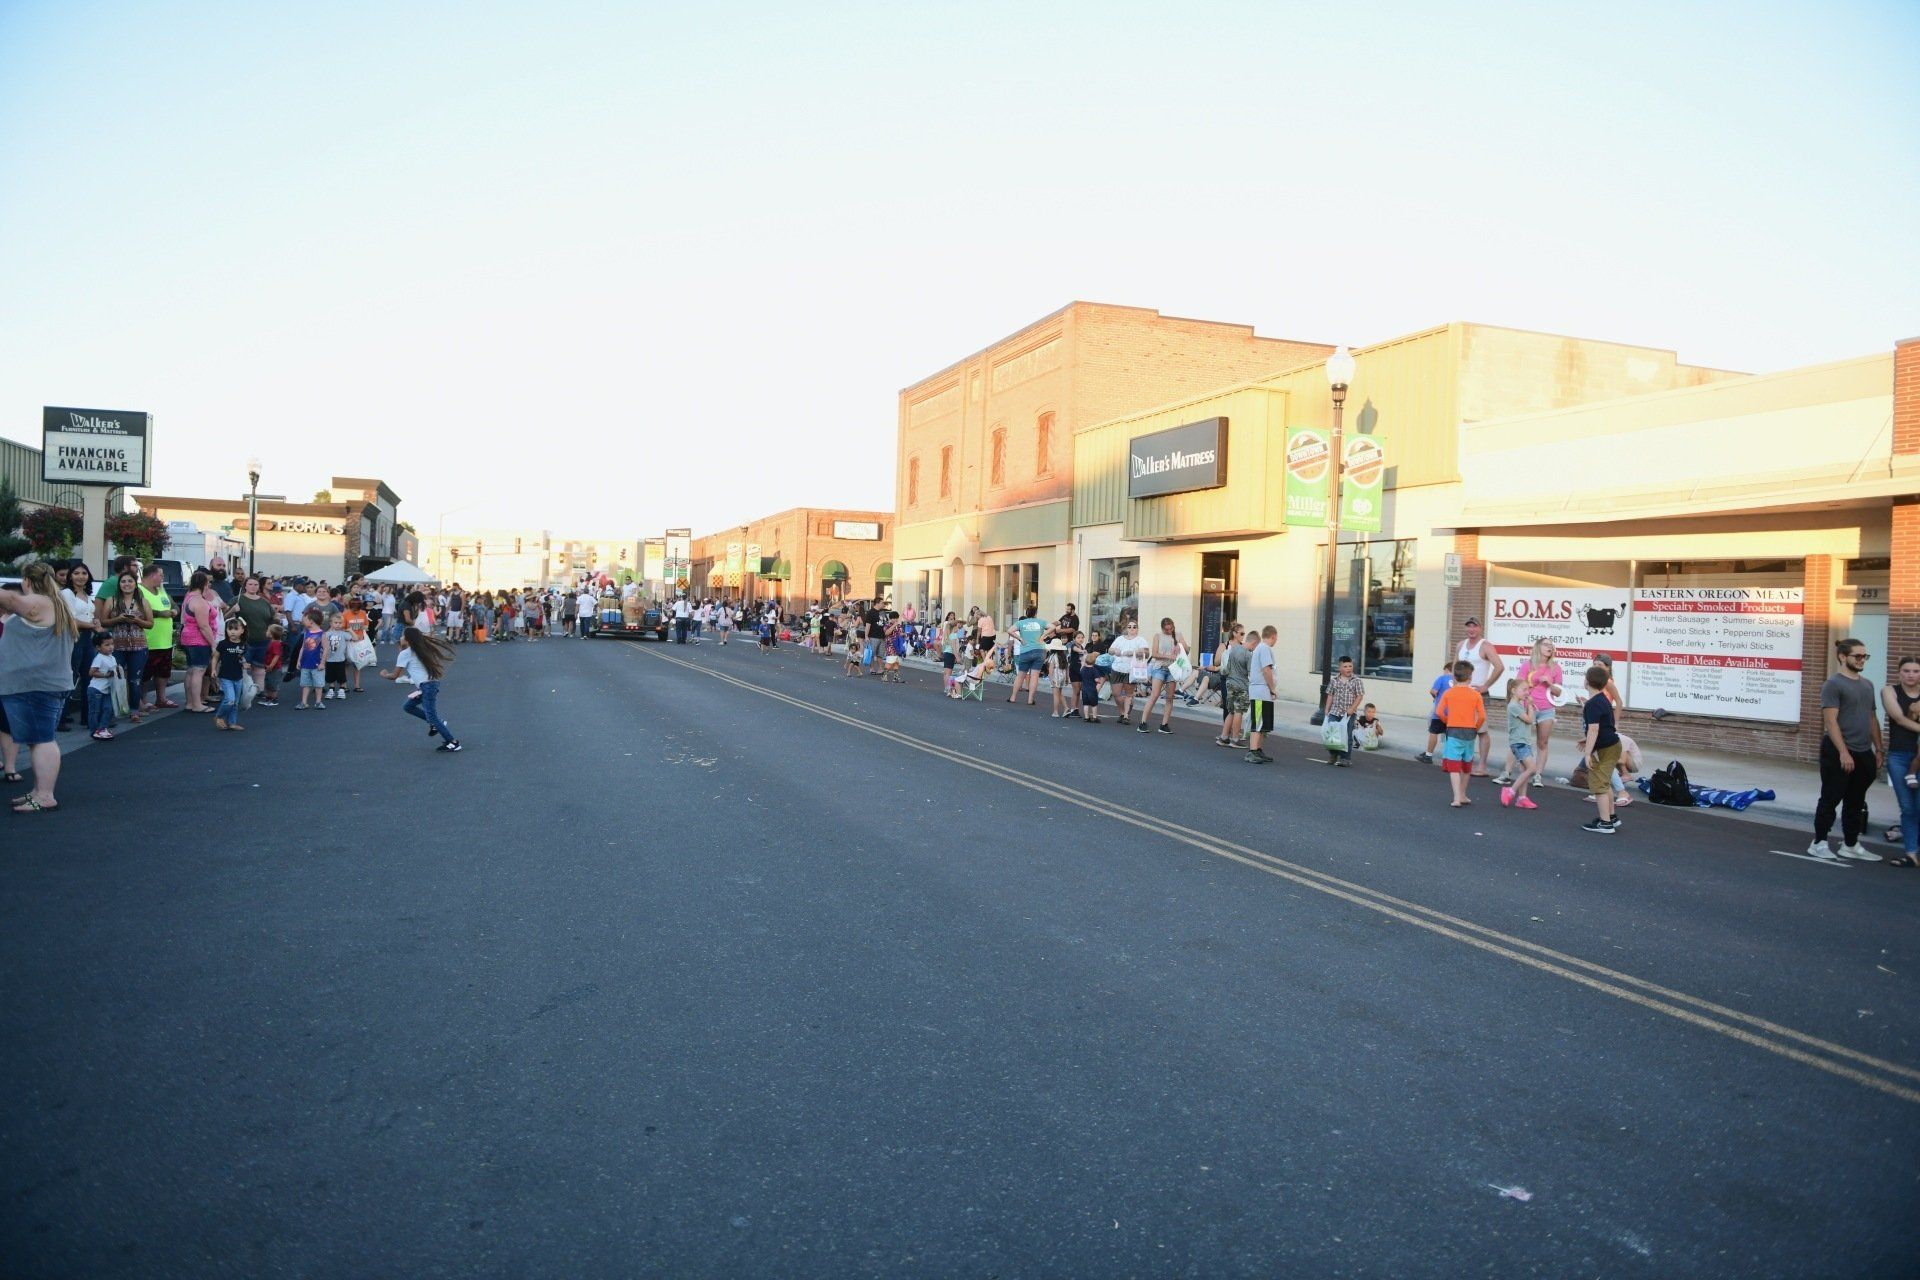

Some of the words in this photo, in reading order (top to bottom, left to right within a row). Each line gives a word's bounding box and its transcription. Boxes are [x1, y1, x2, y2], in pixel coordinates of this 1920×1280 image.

[59, 446, 125, 459] FINANCING
[58, 459, 128, 472] AVAILABLE
[1288, 494, 1326, 511] Miller
[1641, 589, 1694, 599] EASTERN
[1698, 589, 1750, 599] OREGON
[1756, 590, 1799, 599] MEATS
[1861, 588, 1879, 598] 253
[1494, 599, 1572, 619] E.O.M.S
[1652, 601, 1694, 612] Specialty
[1697, 601, 1736, 611] Smoked
[1740, 602, 1786, 613] Products
[1677, 615, 1710, 625] Sausage
[1722, 616, 1756, 624] Summer
[1758, 617, 1795, 627] Sausage
[1653, 627, 1686, 636] Jalapeno
[1689, 627, 1711, 635] Sticks
[1723, 628, 1764, 638] Pepperoni
[1766, 629, 1790, 638] Sticks
[1685, 640, 1706, 649] Jerky
[1718, 640, 1747, 650] Teriyaki
[1749, 641, 1774, 650] Sticks
[1662, 653, 1690, 665] Retail
[1693, 655, 1721, 666] Meats
[1724, 657, 1769, 669] Available
[1665, 690, 1677, 698] Let
[1690, 692, 1714, 701] "Meat"
[1716, 694, 1734, 702] Your
[1735, 695, 1761, 704] Needs!
